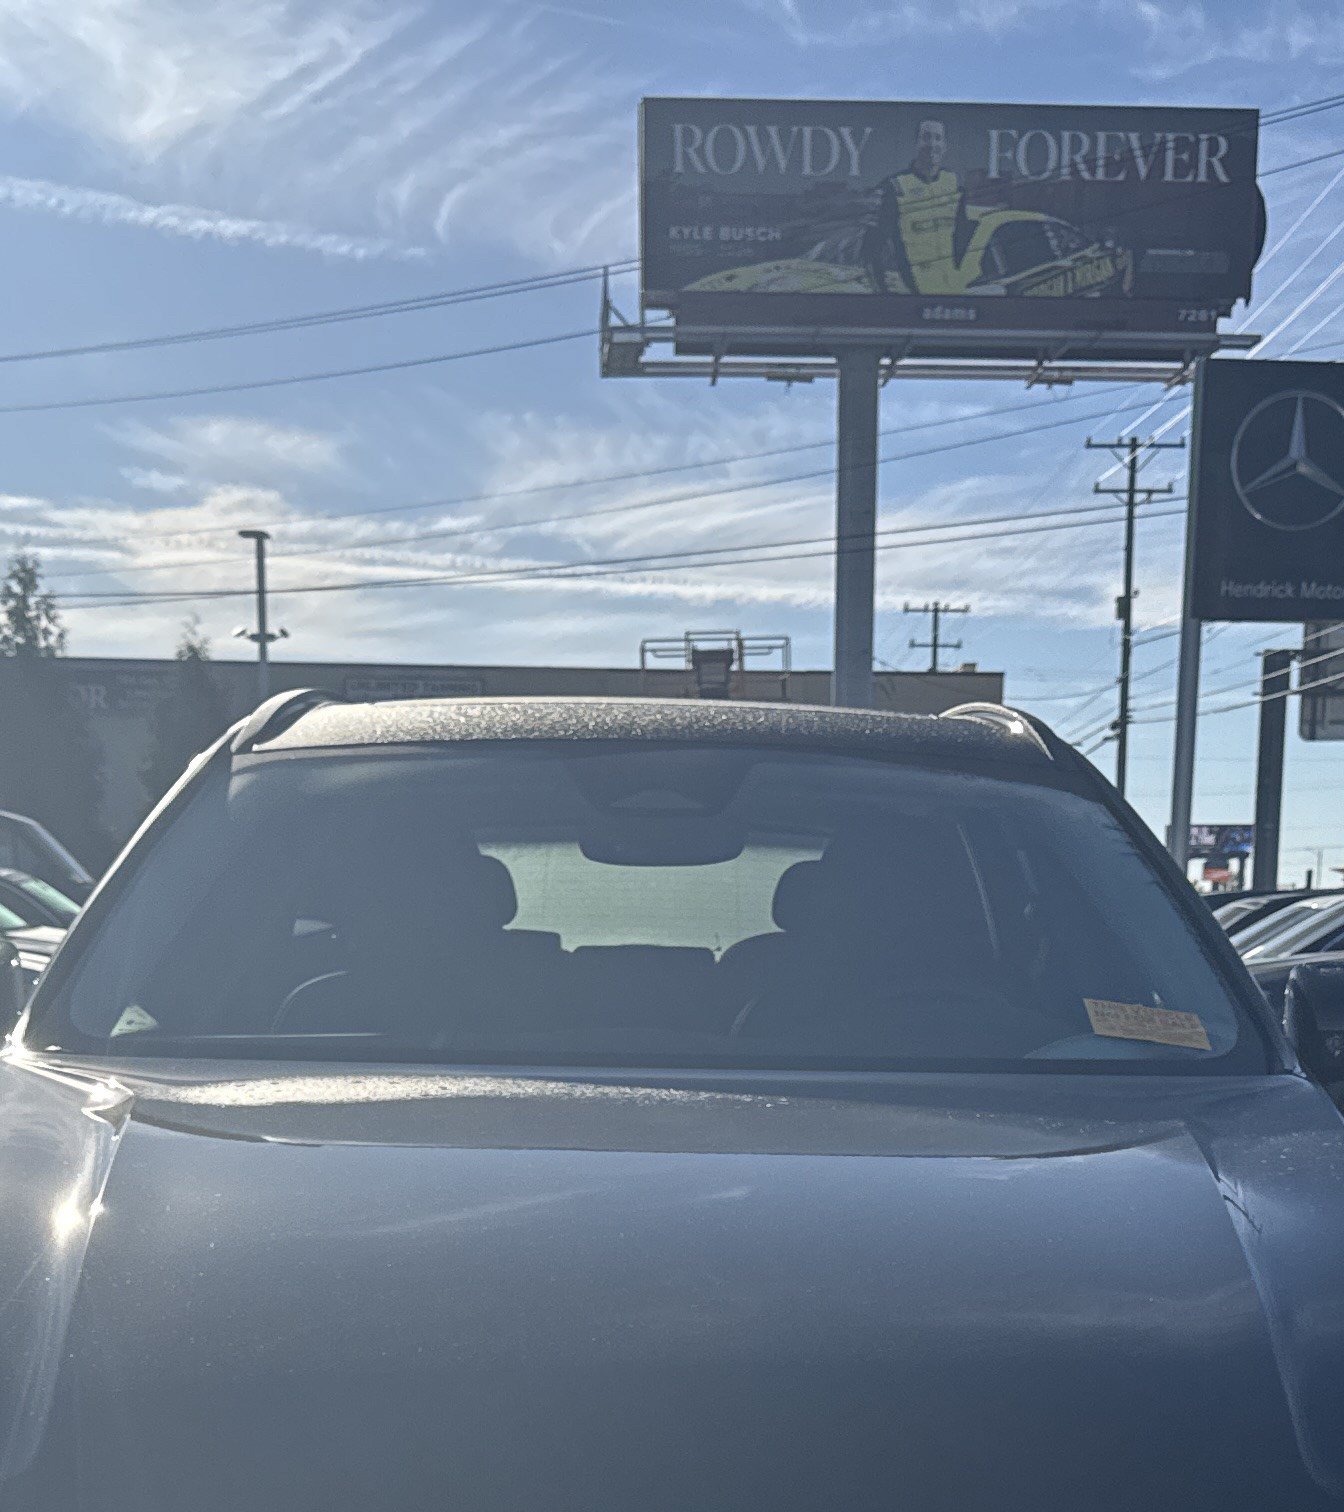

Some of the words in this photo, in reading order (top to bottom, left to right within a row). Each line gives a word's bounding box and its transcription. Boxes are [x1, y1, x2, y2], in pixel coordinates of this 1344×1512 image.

[671, 123, 874, 178] ROWDY
[986, 128, 1232, 186] FOREVER
[668, 225, 714, 240] KYLE
[718, 225, 783, 241] BUSCH
[922, 305, 977, 320] adams
[1219, 580, 1295, 599] Hendrick
